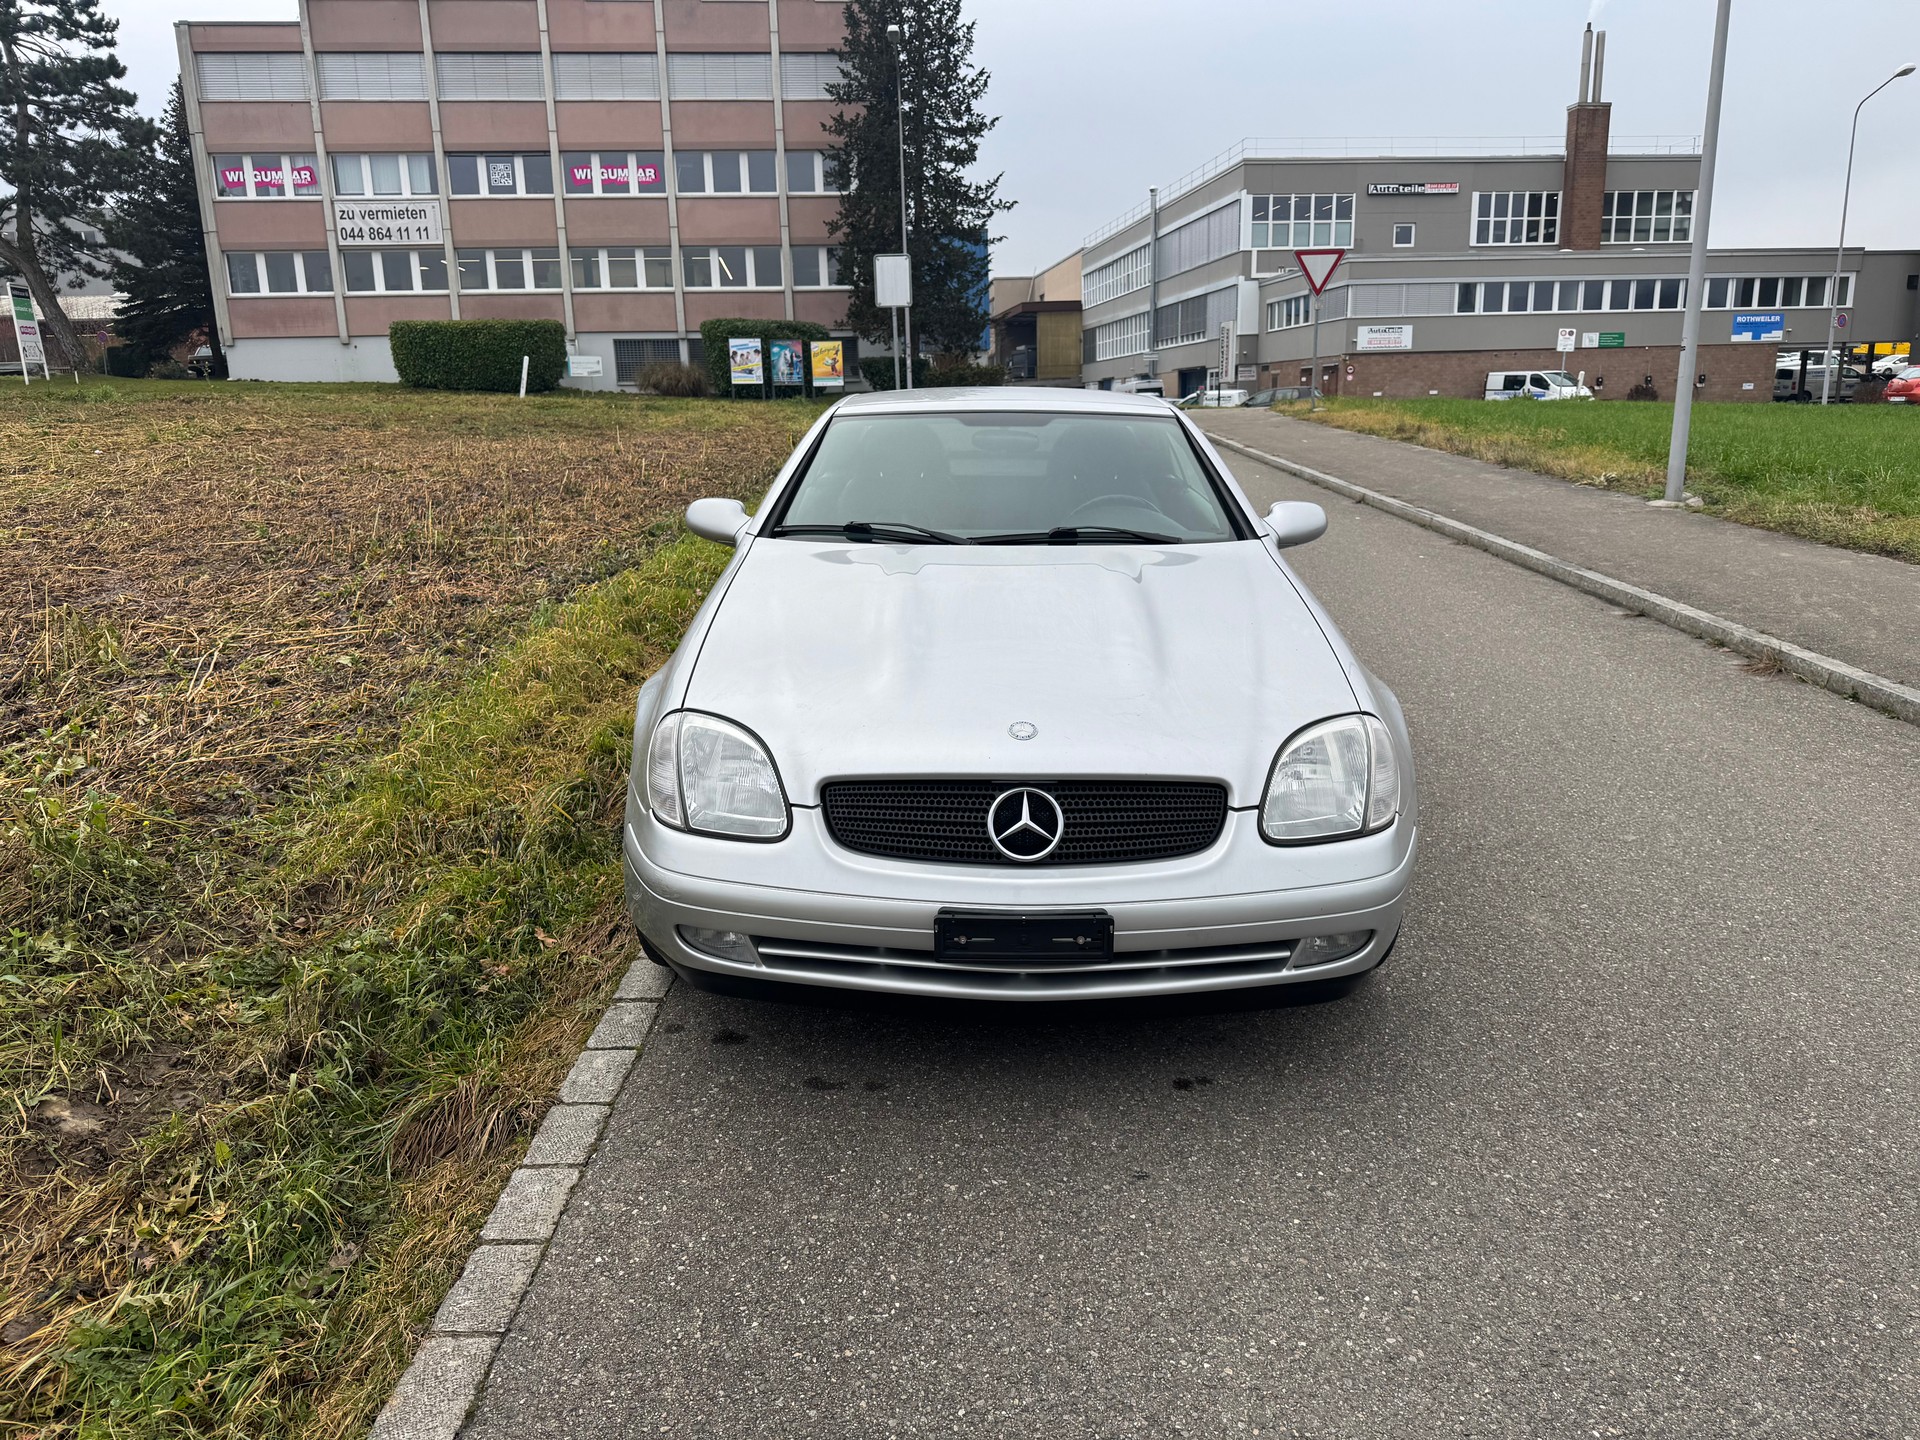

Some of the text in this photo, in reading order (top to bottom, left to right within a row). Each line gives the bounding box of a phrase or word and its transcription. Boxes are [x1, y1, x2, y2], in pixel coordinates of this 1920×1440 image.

[225, 170, 312, 182] WIGUMAR
[574, 168, 656, 179] WIGUMAR
[1370, 184, 1425, 194] Autoteile
[339, 206, 427, 220] zu vermieten
[340, 226, 430, 240] 044 864 11 11
